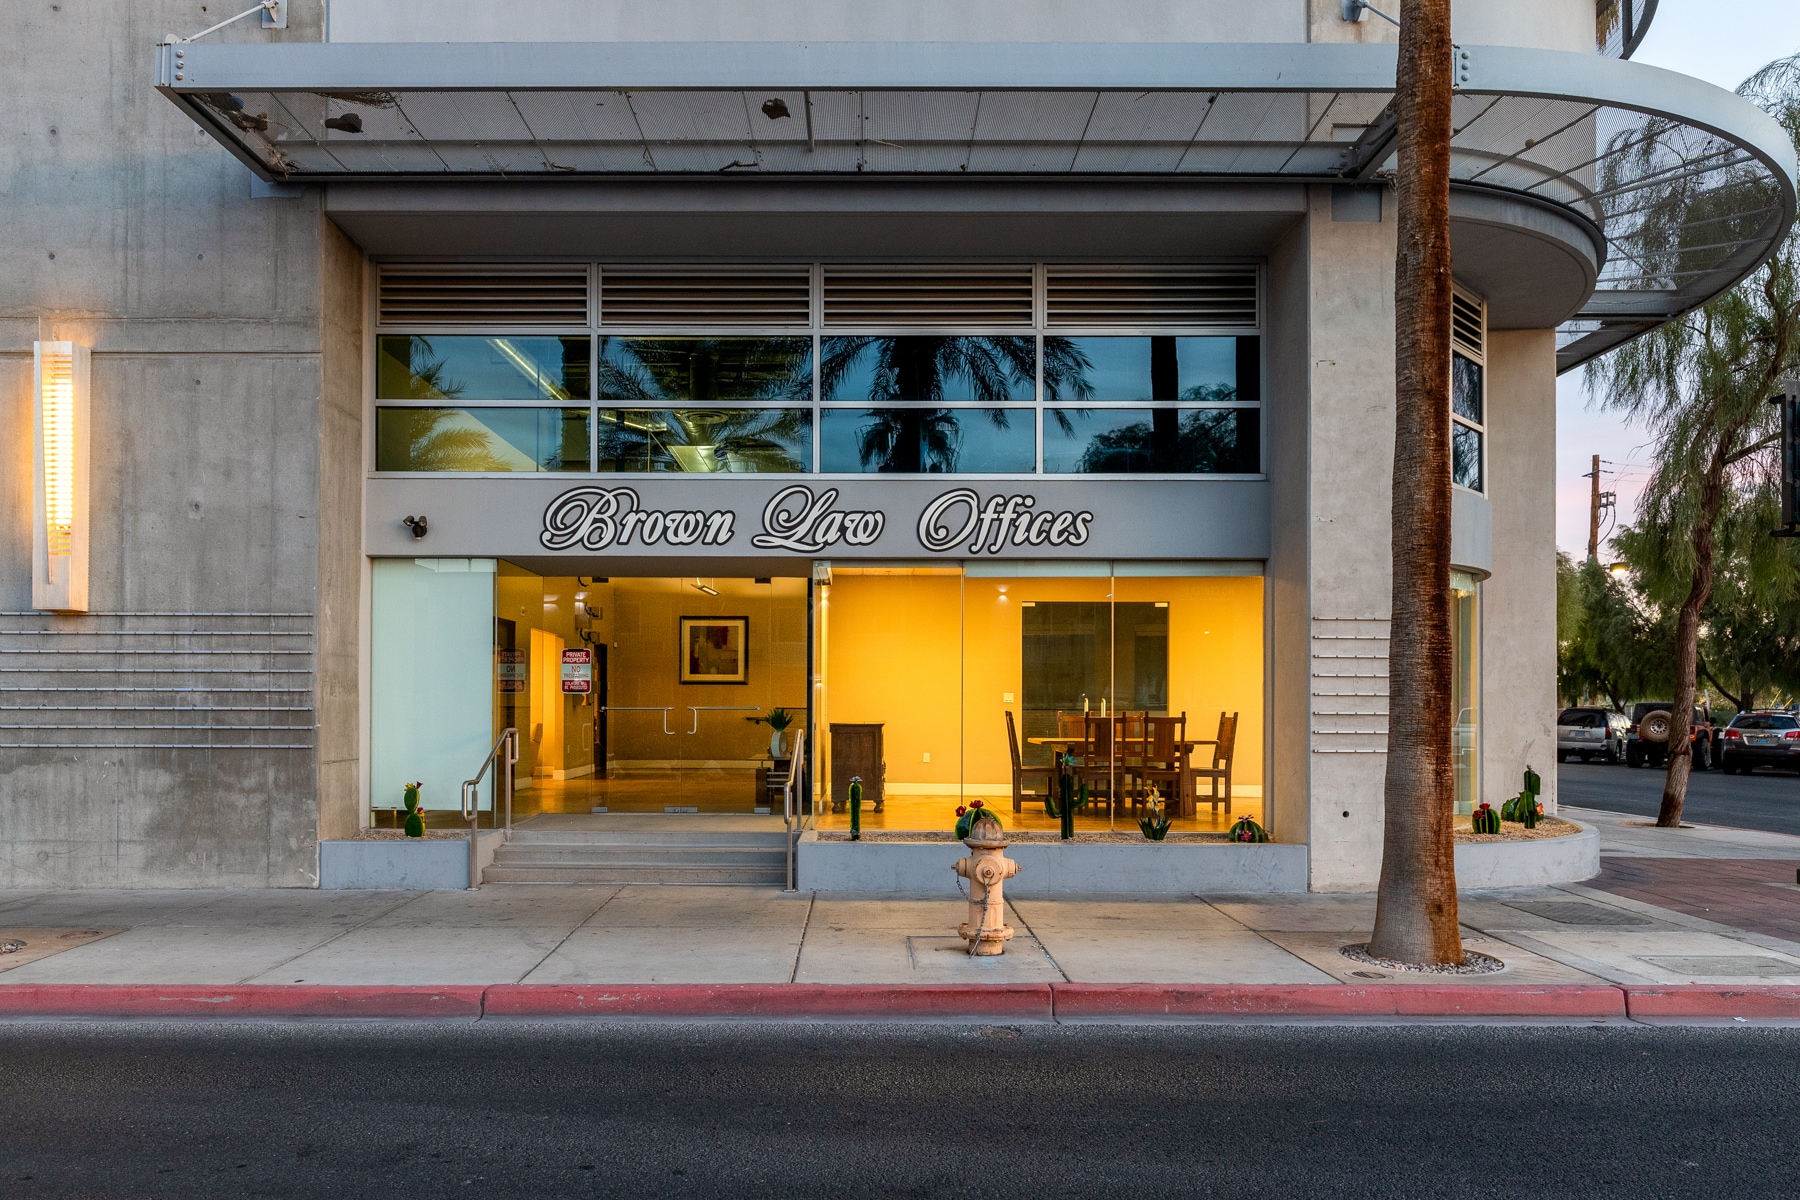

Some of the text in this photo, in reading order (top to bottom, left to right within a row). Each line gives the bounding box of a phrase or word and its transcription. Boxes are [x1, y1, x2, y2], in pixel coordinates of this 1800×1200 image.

[540, 484, 1094, 553] Brown Law Offices
[571, 665, 581, 673] NO
